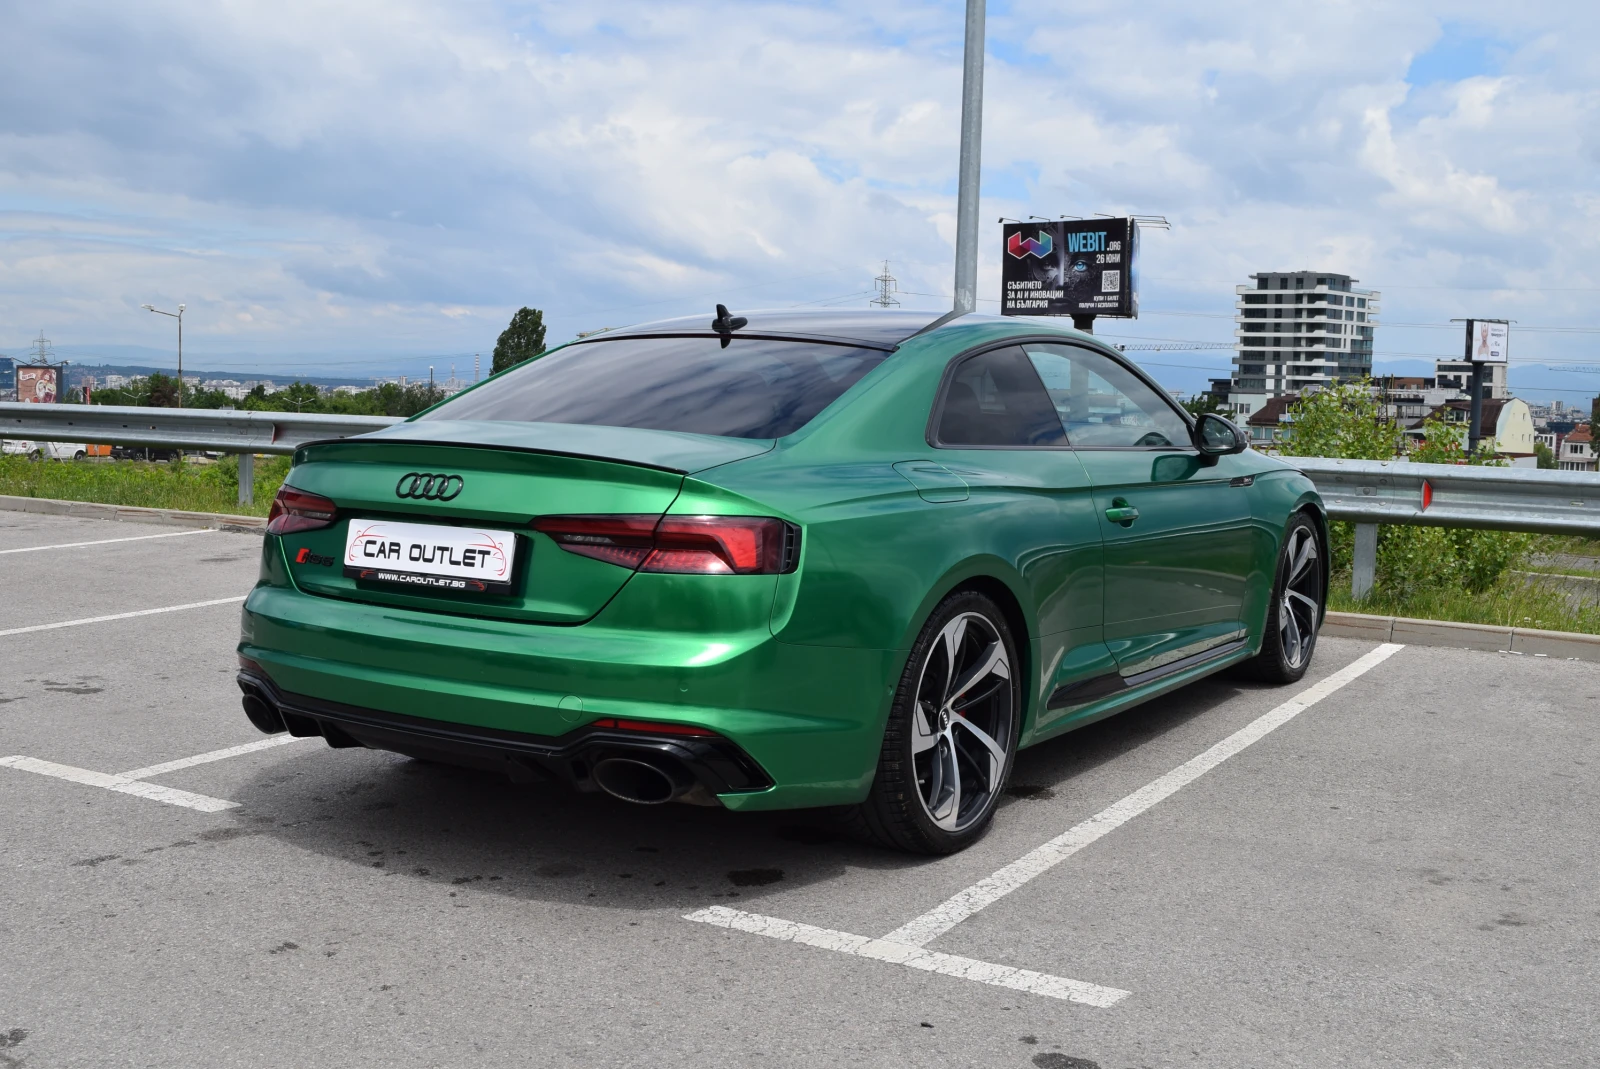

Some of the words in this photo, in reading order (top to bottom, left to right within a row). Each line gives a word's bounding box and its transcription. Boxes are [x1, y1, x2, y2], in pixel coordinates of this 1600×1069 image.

[1096, 254, 1105, 264] 26
[1105, 253, 1121, 264] ЮНИ
[1007, 280, 1042, 290] СЪБИТИЕТО
[1007, 290, 1016, 299] ЗА
[1030, 290, 1064, 300] ИНОВАЦИИ
[1006, 299, 1016, 309] НА
[1016, 299, 1049, 309] БЪЛГАРИЯ
[363, 540, 401, 560] CAR
[409, 544, 492, 568] OUTLET
[378, 572, 466, 588] WWW.CAROUTLET.BG
